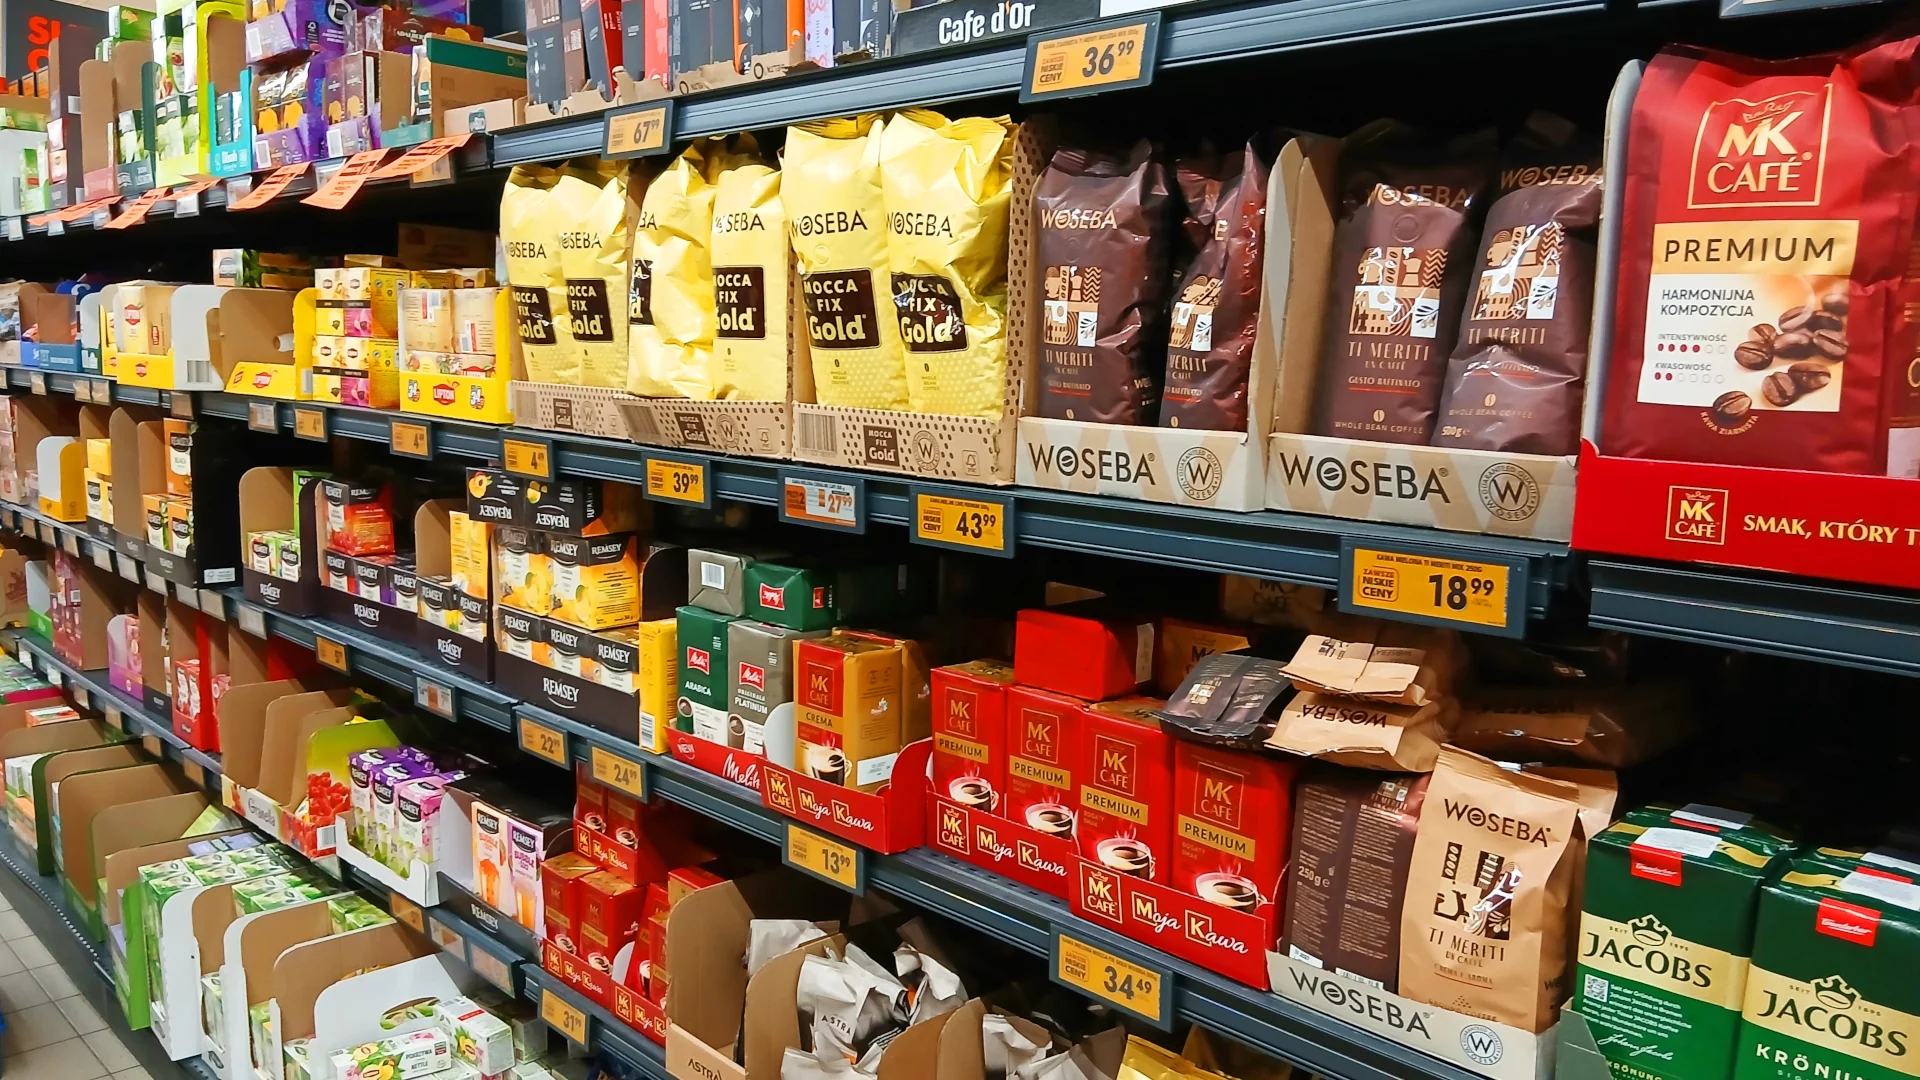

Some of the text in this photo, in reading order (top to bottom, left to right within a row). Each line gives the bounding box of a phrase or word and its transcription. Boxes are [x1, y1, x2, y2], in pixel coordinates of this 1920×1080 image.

[939, 1, 1035, 45] Cafe d'Or
[1041, 63, 1064, 72] NISKIE
[1039, 72, 1062, 83] CENY
[1717, 111, 1804, 158] MK
[1500, 165, 1604, 189] WOSEBA
[1707, 157, 1803, 194] CAFÉ
[1367, 183, 1474, 207] WOSEBA
[1041, 209, 1117, 230] WOSEBA
[1664, 237, 1835, 263] PREMIUM
[804, 279, 858, 294] MOCCA
[1662, 288, 1755, 302] HARMONIJNA
[572, 300, 588, 311] FIX
[719, 291, 738, 304] FIX
[817, 298, 843, 311] FIX
[910, 298, 936, 312] FIX
[518, 305, 531, 317] FIX
[1660, 304, 1754, 318] KOMPOZYCJA
[809, 315, 866, 340] Gold
[901, 316, 953, 343] Gold
[1468, 329, 1481, 345] TI
[1658, 333, 1727, 342] INTENSYWNOŚĆ
[1349, 342, 1429, 361] TI MERITI
[1655, 362, 1712, 371] KWASOWOŚĆ
[1348, 375, 1375, 385] GUSTO
[1335, 421, 1423, 435] WHOLE BEAN COFFEE
[1700, 411, 1759, 435] KAWA ZIARNISTA
[684, 430, 705, 442] Gold
[868, 430, 892, 438] MOCCA
[869, 447, 896, 461] Gold
[918, 442, 933, 459] W
[1028, 442, 1156, 486] WOSEBA
[1187, 461, 1211, 485] W
[1279, 452, 1451, 504] WOSEBA
[1490, 478, 1525, 505] W
[479, 504, 512, 520] REMSEY
[1679, 500, 1716, 522] MK
[536, 513, 570, 529] REMSEY
[923, 523, 941, 531] CENY
[1674, 520, 1716, 539] CAFÉ
[1743, 514, 1899, 544] SMAK, KTÓRY
[550, 539, 578, 557] REMSEY
[591, 543, 622, 555] REMSEY
[327, 555, 346, 570] REMSEY
[1377, 554, 1394, 562] KAWA
[1452, 563, 1464, 571] MIX
[1465, 565, 1483, 573] 250G
[357, 564, 379, 581] REMSEY
[394, 574, 417, 589] REMSEY
[1363, 568, 1394, 579] ZAWSZE
[260, 585, 281, 599] REMSEY
[1362, 577, 1394, 588] NISKIE
[421, 586, 444, 603] REMSEY
[1362, 587, 1393, 599] CENY
[353, 603, 380, 622] REMSEY
[504, 615, 530, 633] REMSEY
[550, 628, 578, 648] REMSEY
[437, 640, 462, 659] REMSEY
[598, 644, 630, 663] REMSEY
[543, 677, 579, 702] REMSEY
[685, 681, 711, 696] ARABICA
[811, 674, 828, 693] MK
[737, 688, 766, 702] ORIGINALS
[734, 697, 768, 715] PLATINUM
[951, 700, 970, 719] MK
[806, 712, 833, 728] CREMA
[1301, 704, 1387, 728] WOSEBA
[1028, 721, 1052, 743] MK
[677, 743, 695, 755] NEW
[939, 738, 983, 758] PREMIUM
[1103, 749, 1128, 773] MK
[1014, 762, 1064, 785] PREMIUM
[771, 778, 788, 797] MK
[1205, 778, 1234, 805] MK
[801, 793, 874, 832] Moja Kawa
[1086, 792, 1140, 819] PREMIUM
[477, 813, 497, 830] REMSEY
[943, 815, 962, 835] MK
[1444, 798, 1549, 847] WOSEBA
[512, 830, 535, 848] REMSEY
[1184, 822, 1246, 853] PREMIUM
[980, 831, 1068, 877] Moja Kawa
[1089, 877, 1113, 901] MK
[471, 903, 498, 929] REMSEY
[1136, 901, 1248, 955] Moja Kawa
[1429, 927, 1505, 961] TI MERITI
[1609, 925, 1689, 952] SEIT 1895
[1065, 957, 1086, 971] NISKIE
[1584, 932, 1712, 988] JACOBS
[1065, 965, 1086, 980] CENY
[1434, 963, 1493, 984] CREMA AROMA
[1288, 967, 1431, 1040] WOSEBA
[1789, 985, 1881, 1017] SEIT 1895
[1757, 989, 1908, 1057] JACOBS
[1470, 1034, 1494, 1054] W
[1756, 1043, 1868, 1080] KRÖNU
